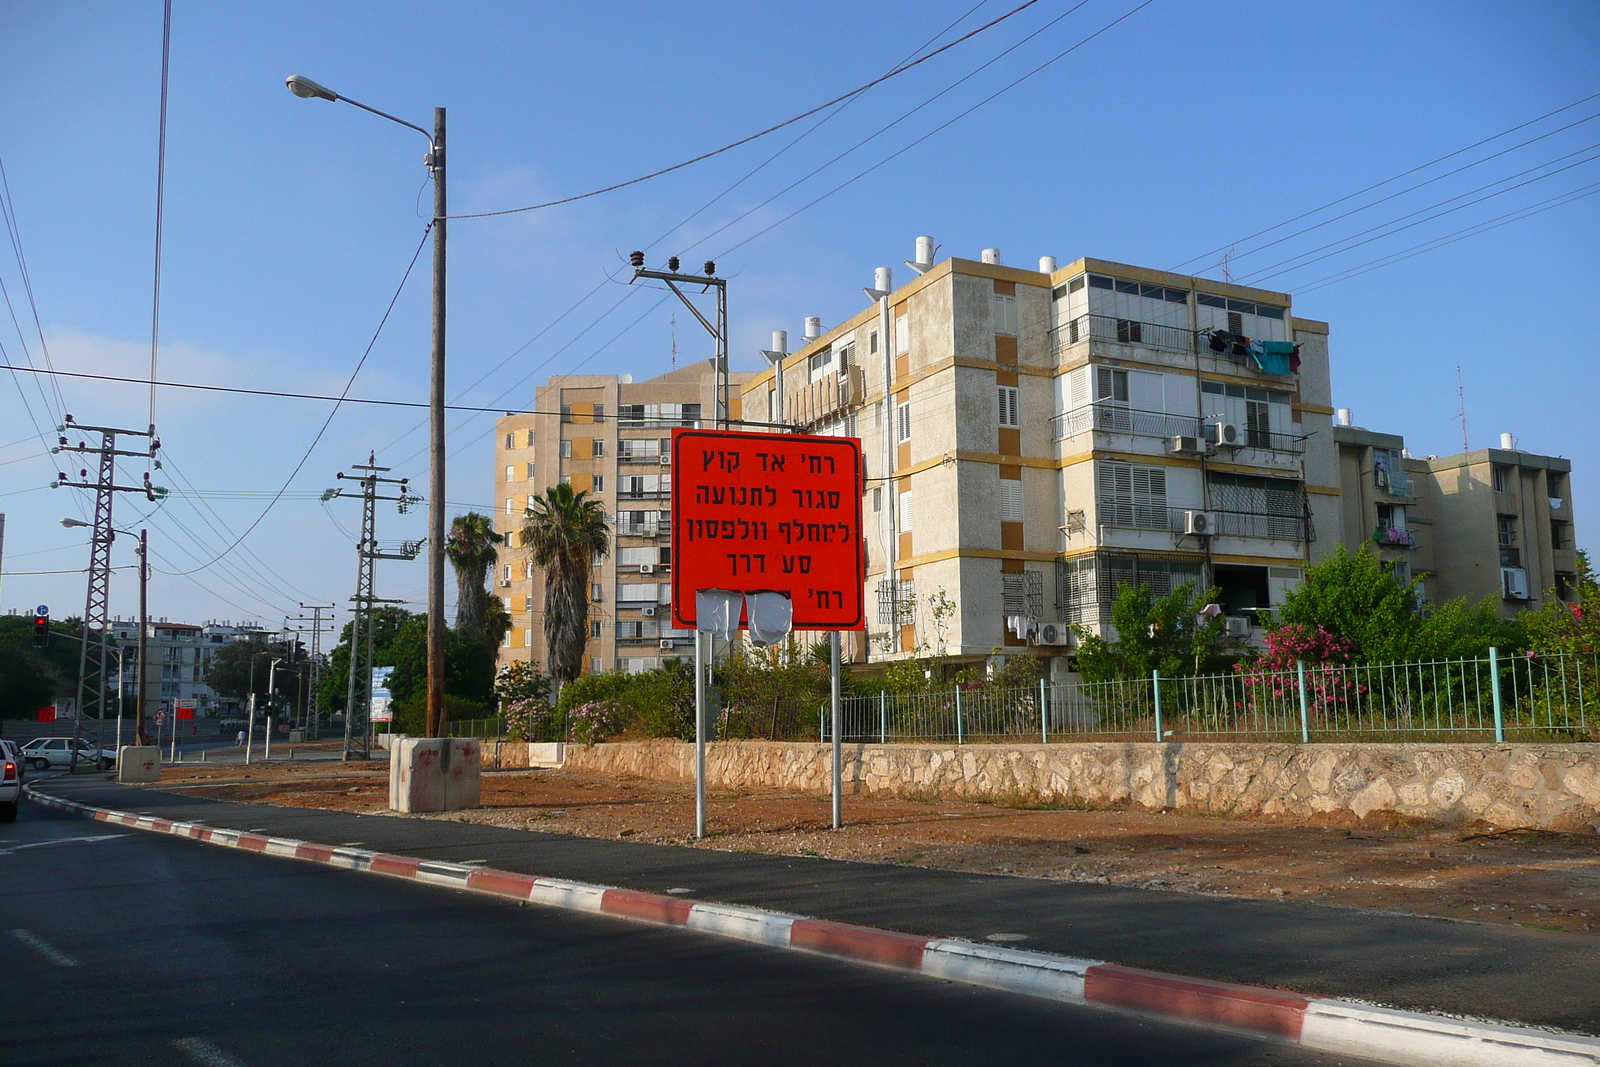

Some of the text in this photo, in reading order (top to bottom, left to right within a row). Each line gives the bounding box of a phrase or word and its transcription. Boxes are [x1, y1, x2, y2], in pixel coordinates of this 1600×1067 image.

[701, 450, 835, 474] רח' אד קוץ
[696, 485, 841, 509] סגור לתנועה
[686, 518, 849, 544] למחלף וולפסון
[726, 553, 812, 576] סע דרך
[808, 588, 843, 609] רח'
